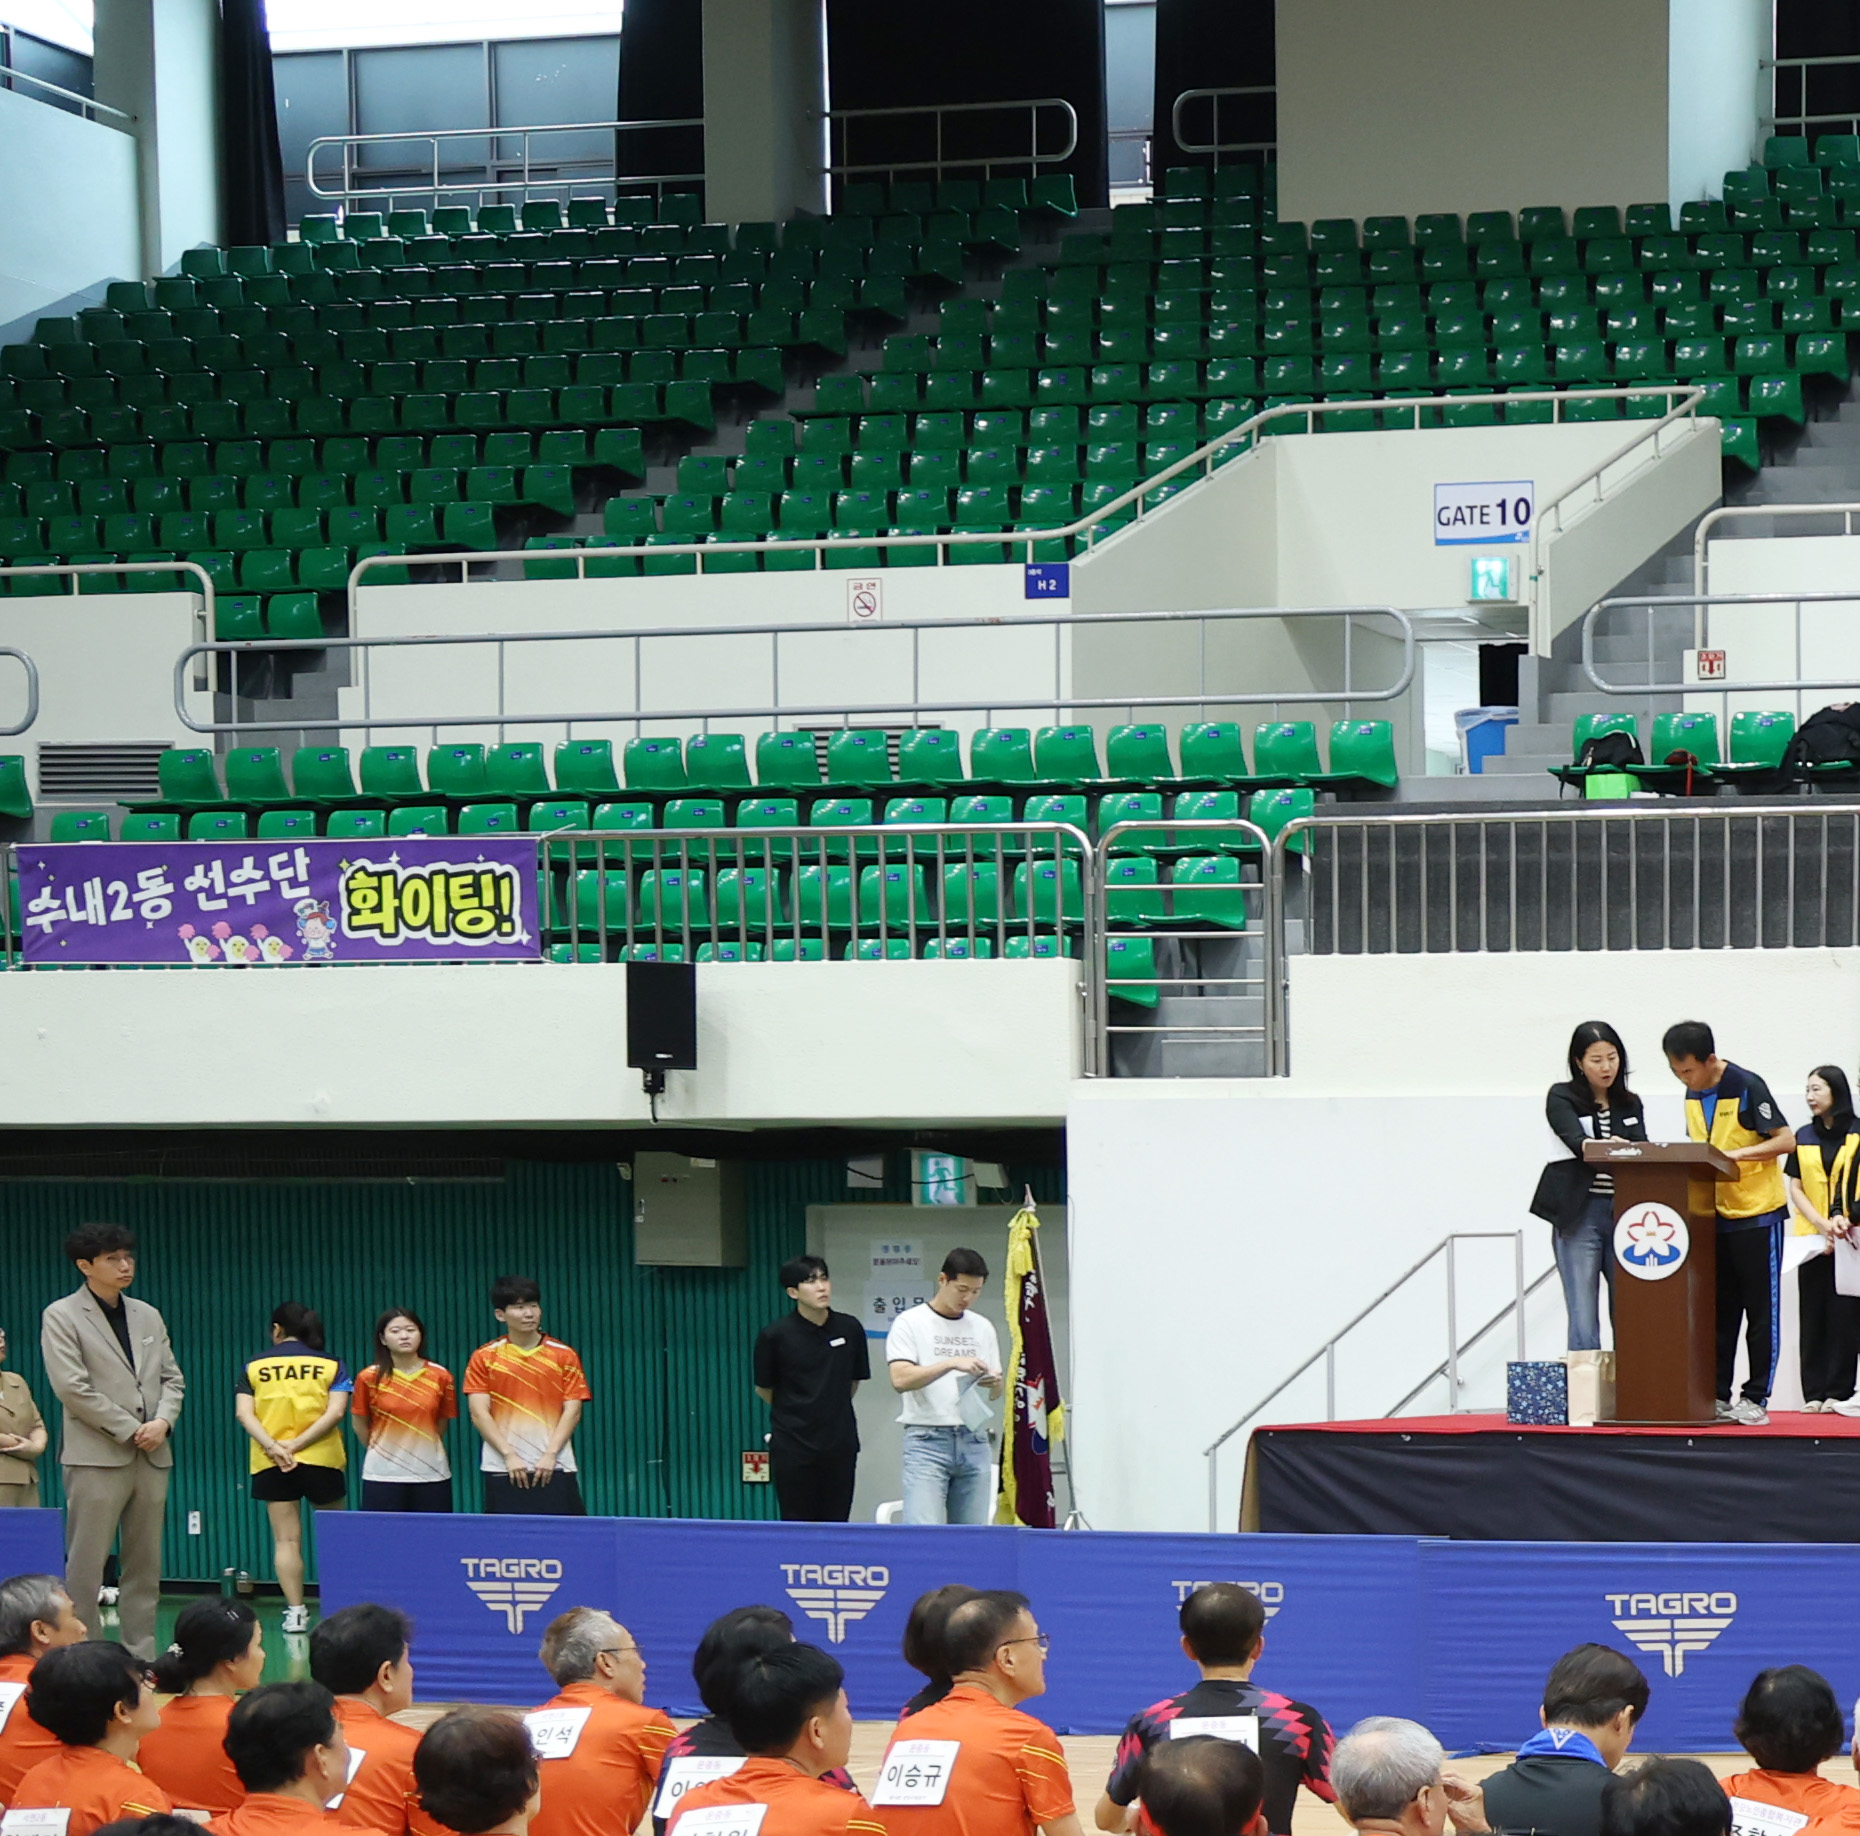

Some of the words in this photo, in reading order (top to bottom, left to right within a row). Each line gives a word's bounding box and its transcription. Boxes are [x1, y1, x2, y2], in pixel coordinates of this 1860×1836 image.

[1437, 504, 1490, 526] GATE
[1495, 497, 1531, 526] 10
[26, 866, 174, 934] 수내2동
[184, 847, 312, 912] 선수단
[350, 871, 513, 936] 화이팅!
[934, 1347, 976, 1357] DREAMS
[259, 1365, 324, 1382] STAFF
[461, 1558, 562, 1579] TAGRO
[780, 1564, 890, 1587] TAGRO
[1171, 1580, 1284, 1602] TRO
[1605, 1592, 1737, 1616] TAGRO
[887, 1764, 941, 1788] 이승규
